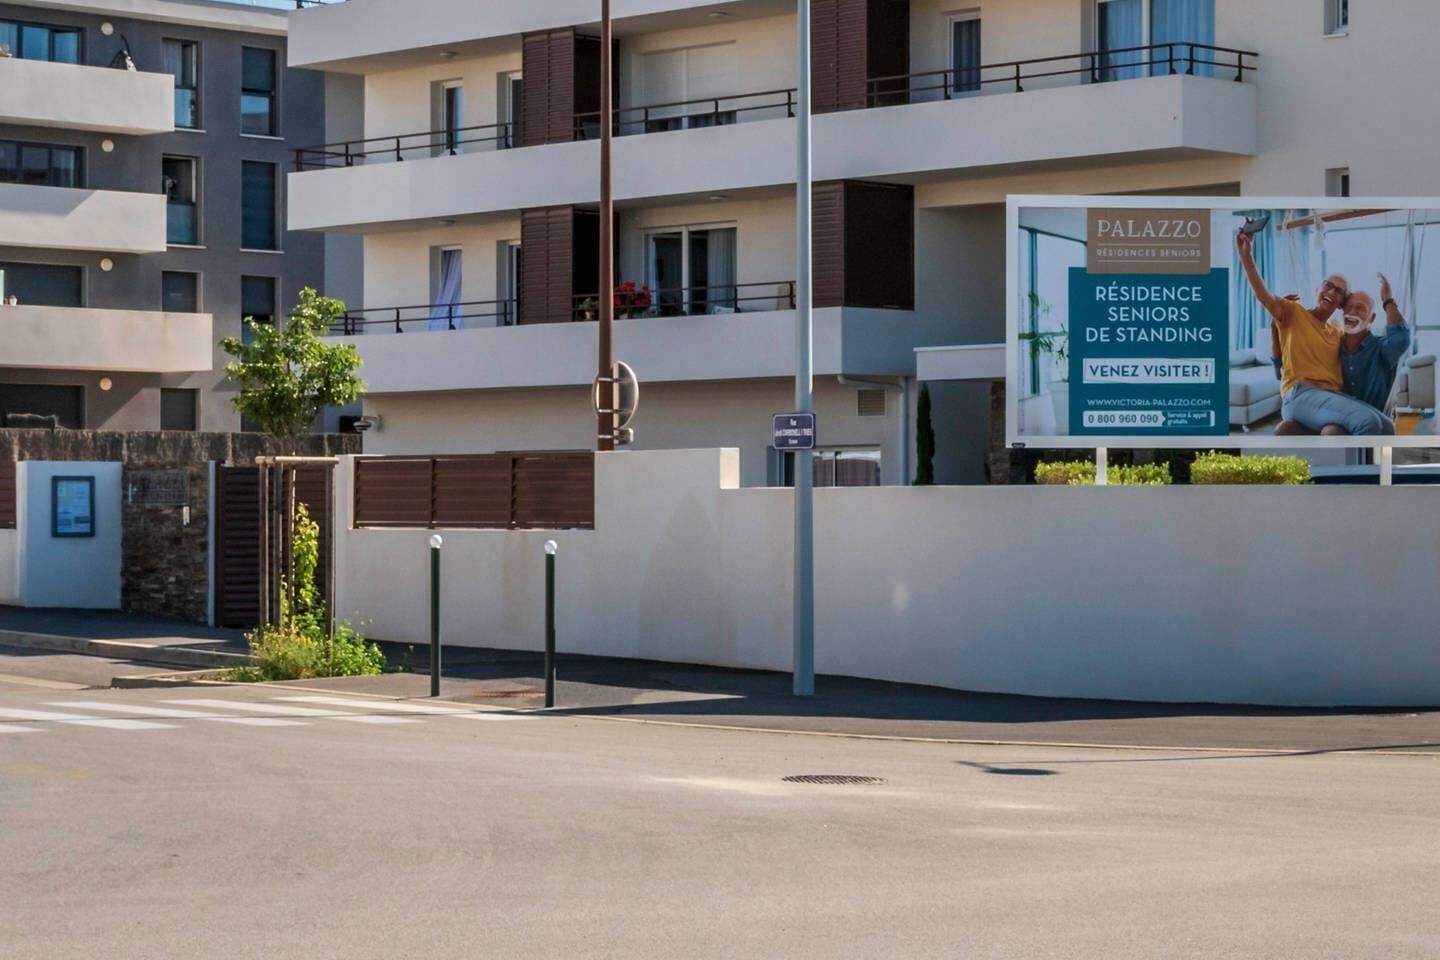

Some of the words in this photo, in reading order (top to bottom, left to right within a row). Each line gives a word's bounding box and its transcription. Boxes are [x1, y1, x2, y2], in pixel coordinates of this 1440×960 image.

[1097, 220, 1201, 238] PALAZZO
[1160, 248, 1201, 257] SENIORS
[1096, 281, 1203, 301] RÉSIDENCE
[1108, 306, 1190, 322] SENIORS
[1086, 327, 1111, 342] DE
[1116, 327, 1213, 342] STANDING
[1089, 365, 1139, 378] VENEZ
[1144, 365, 1200, 378] VISITER
[1204, 365, 1209, 378] !
[1088, 414, 1095, 424] 0
[1097, 414, 1116, 424] 800
[1119, 414, 1137, 424] 960
[1140, 414, 1159, 424] 090
